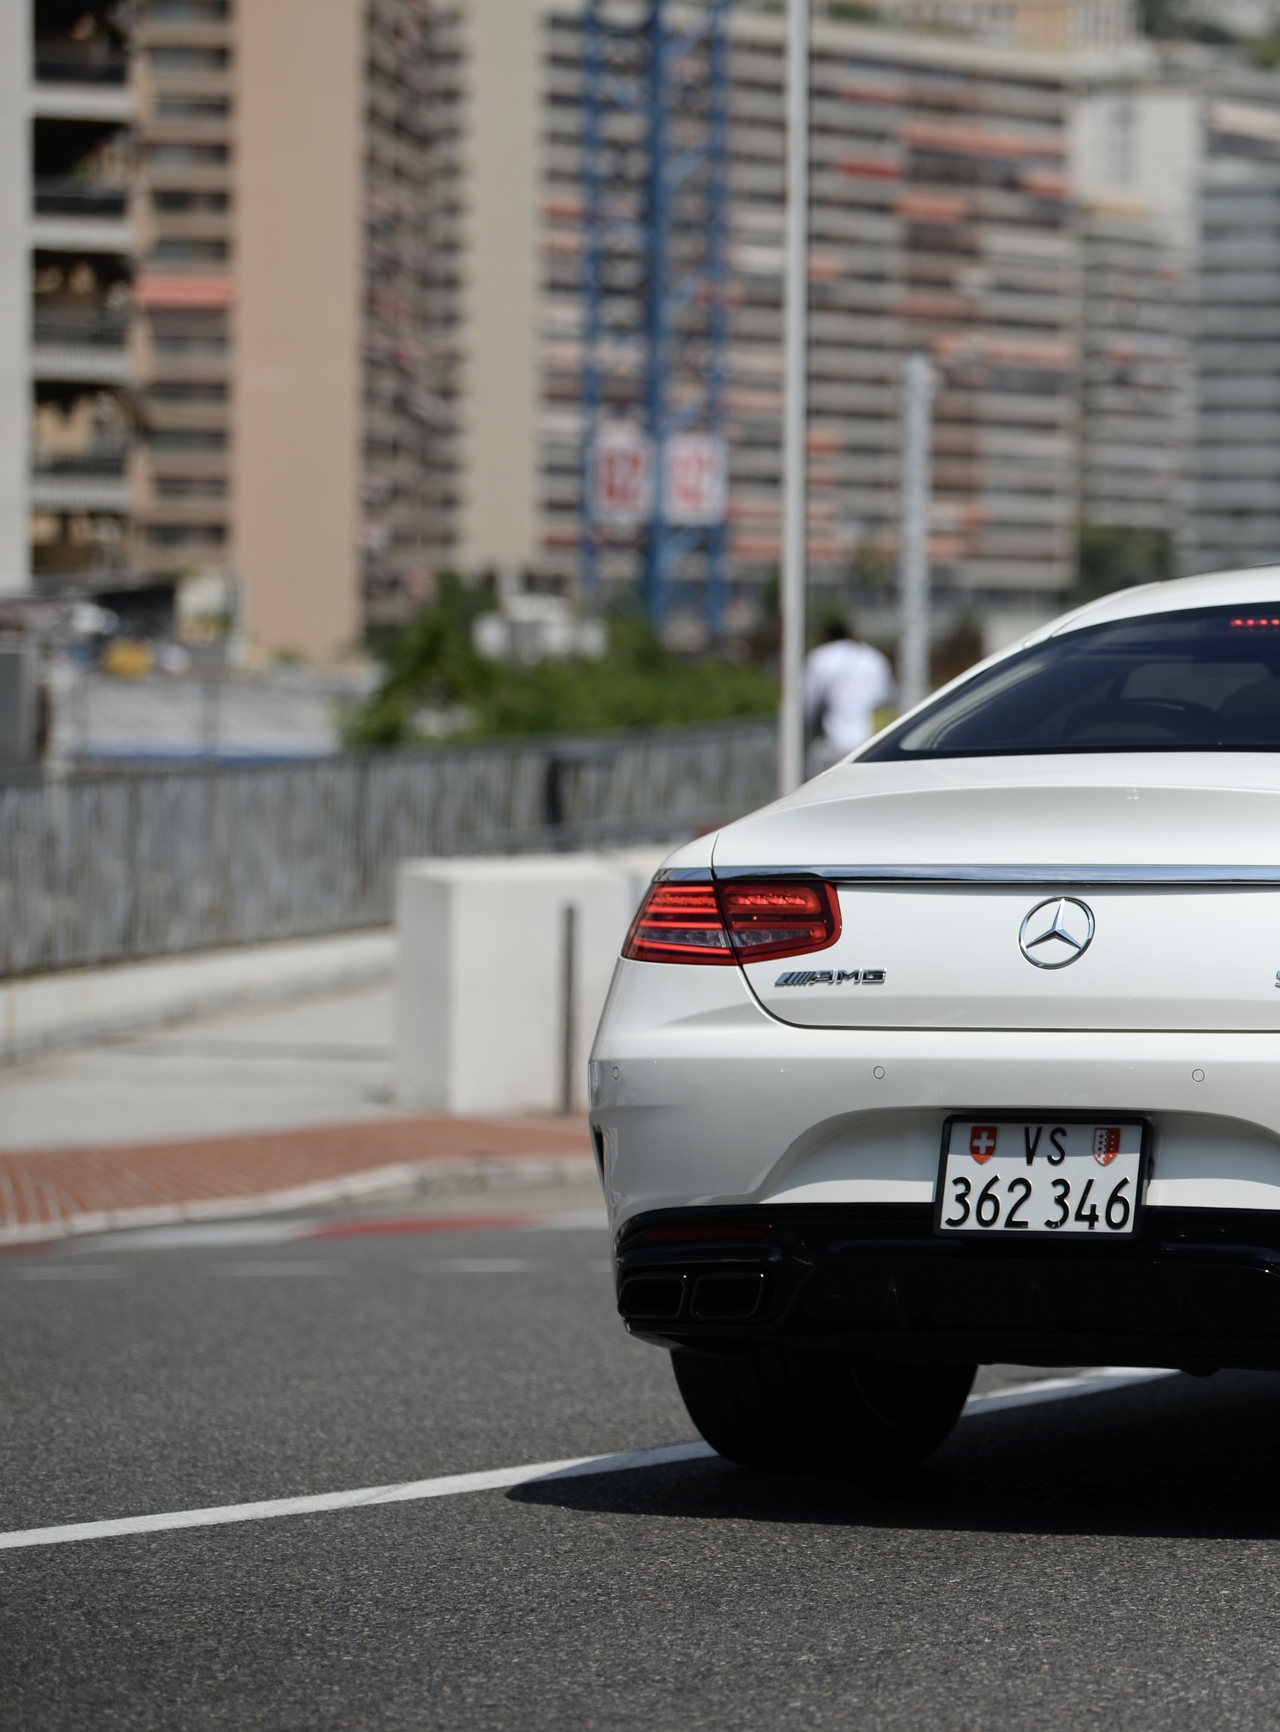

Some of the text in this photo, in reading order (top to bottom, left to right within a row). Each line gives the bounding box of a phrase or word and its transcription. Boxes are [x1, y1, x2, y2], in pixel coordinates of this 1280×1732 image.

[808, 968, 888, 986] AMG
[1024, 1126, 1067, 1166] VS
[945, 1174, 1131, 1231] 362 346
